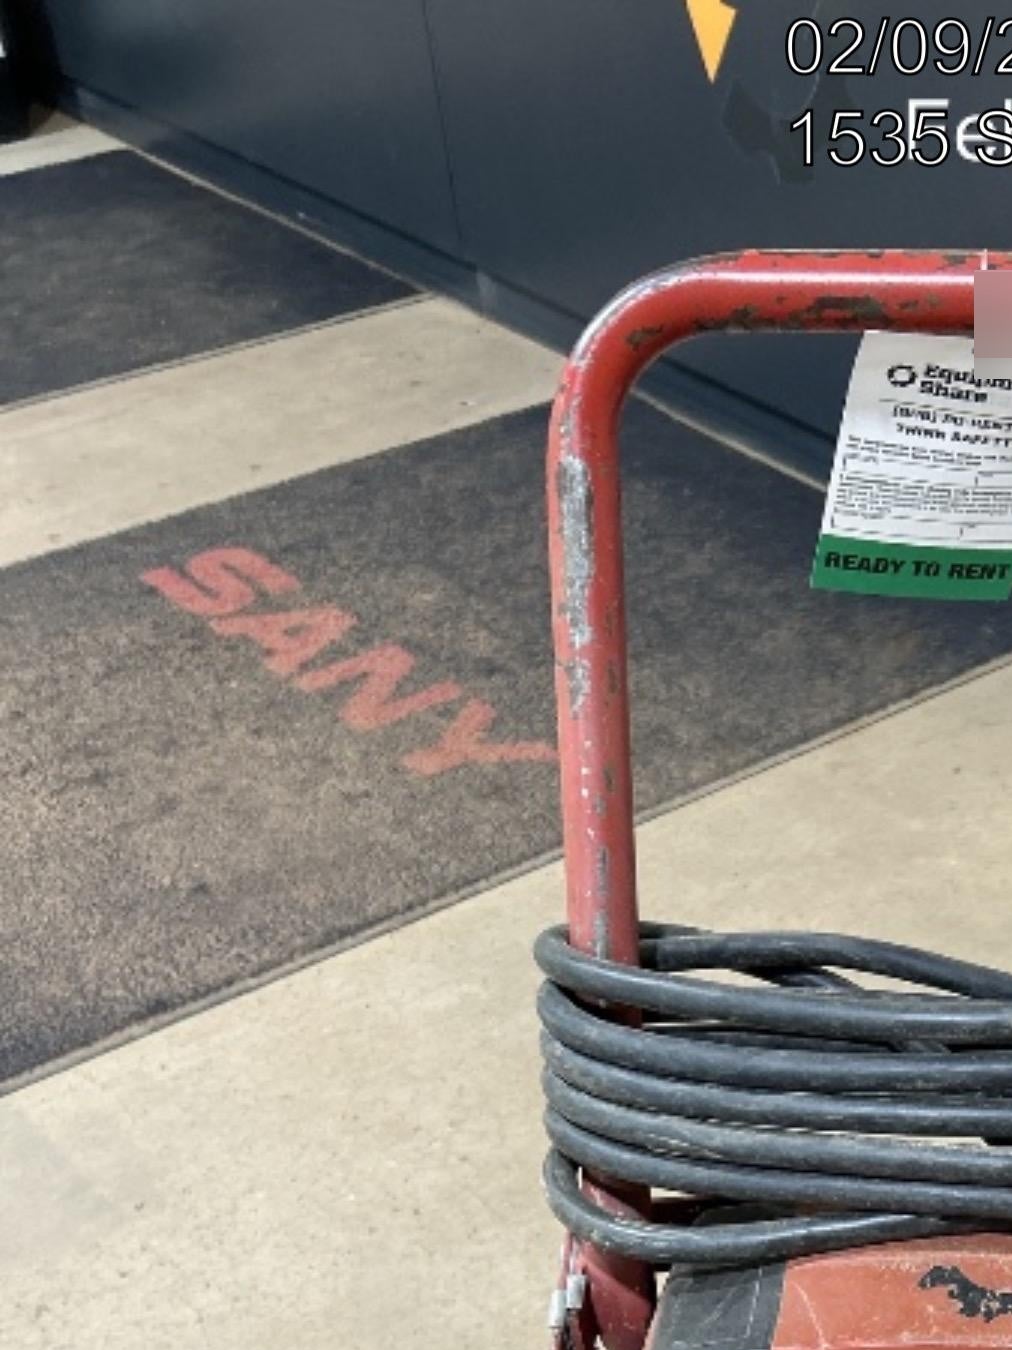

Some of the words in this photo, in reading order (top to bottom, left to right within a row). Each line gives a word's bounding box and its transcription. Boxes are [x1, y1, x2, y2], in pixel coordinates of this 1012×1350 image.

[920, 381, 989, 403] Share
[824, 551, 906, 575] READY
[911, 560, 940, 577] TO
[947, 563, 1012, 580] RENT
[141, 547, 560, 777] SANY
